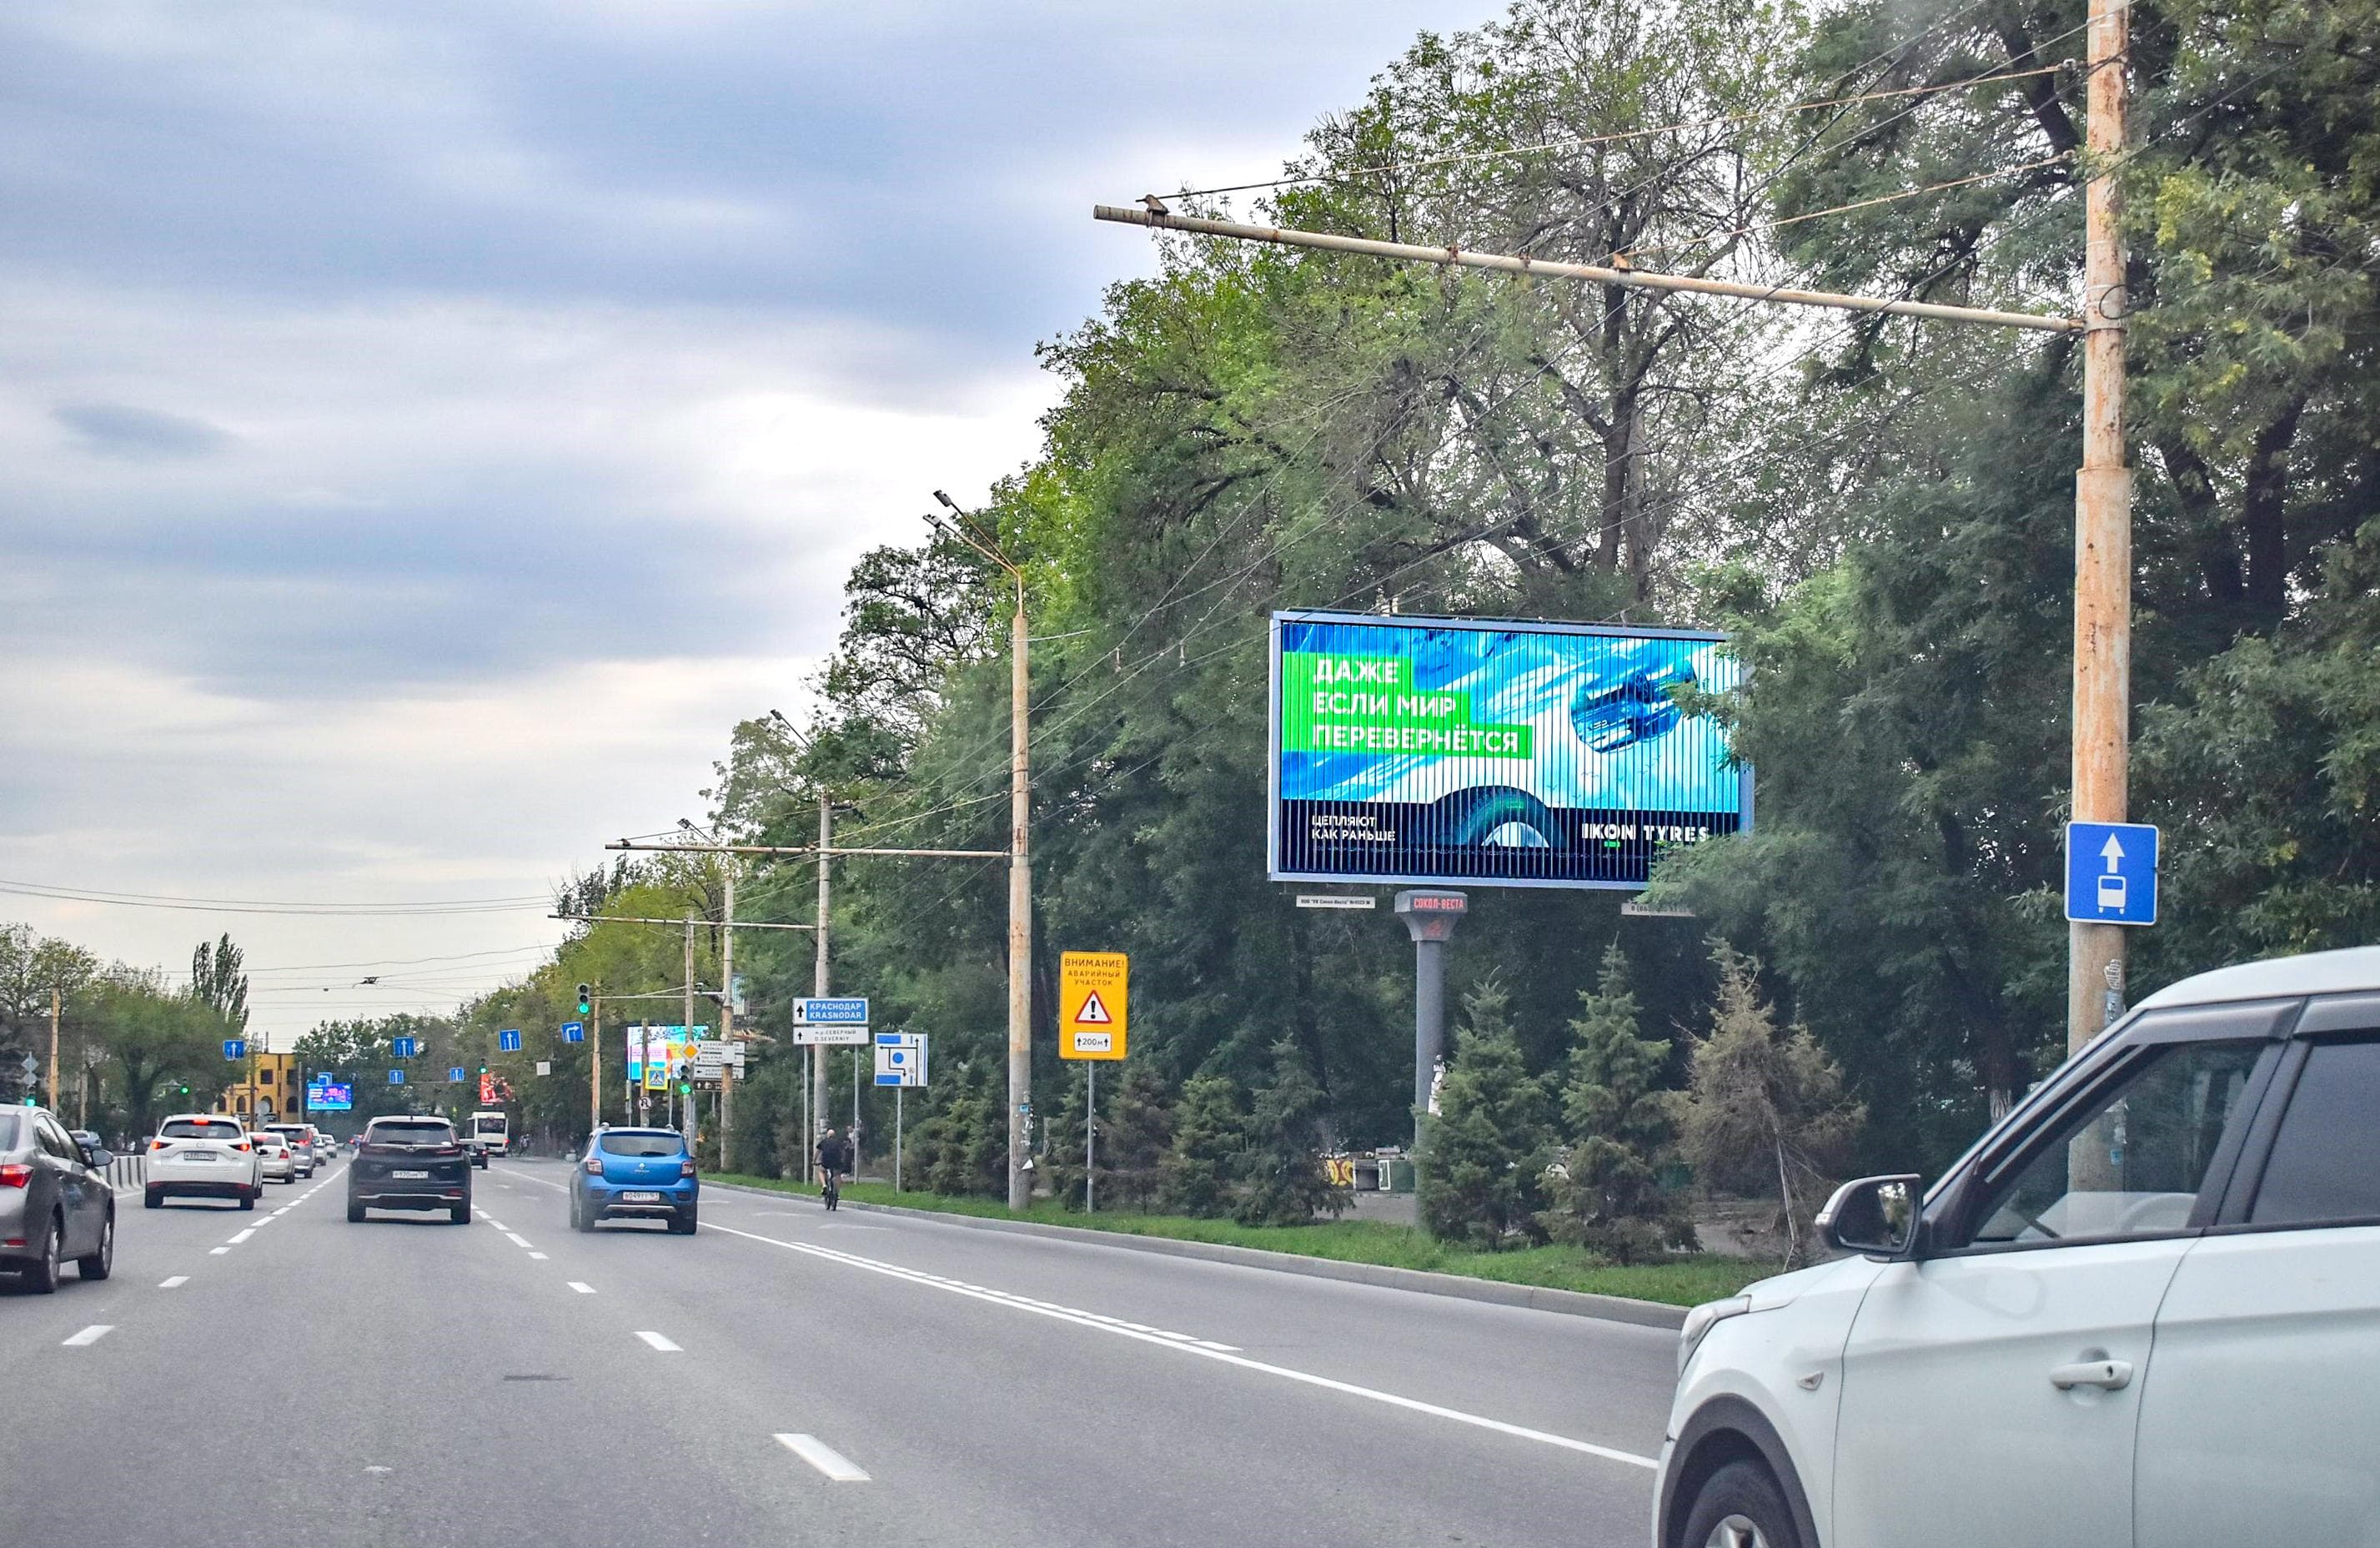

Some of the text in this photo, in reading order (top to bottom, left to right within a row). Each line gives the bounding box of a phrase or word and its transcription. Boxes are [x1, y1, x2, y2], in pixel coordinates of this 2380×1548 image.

[1313, 659, 1398, 685] ДАЖЕ
[1313, 692, 1457, 717] ЕСЛИ МИР
[1313, 724, 1519, 752] ПЕРЕВЕРНЁТСЯ
[1312, 815, 1375, 827] ЦЕПЛЯЮТ
[1312, 829, 1396, 842] КАК РАНЬШЕ
[1581, 823, 1710, 842] IKON TYRES
[1413, 897, 1464, 910] СОКОЛ-ВЕСТА
[1064, 958, 1124, 968] ВНИМАНИЕ!
[1067, 969, 1121, 978] АВАРИЙНЫЙ
[810, 1011, 862, 1019] KRASNODAR
